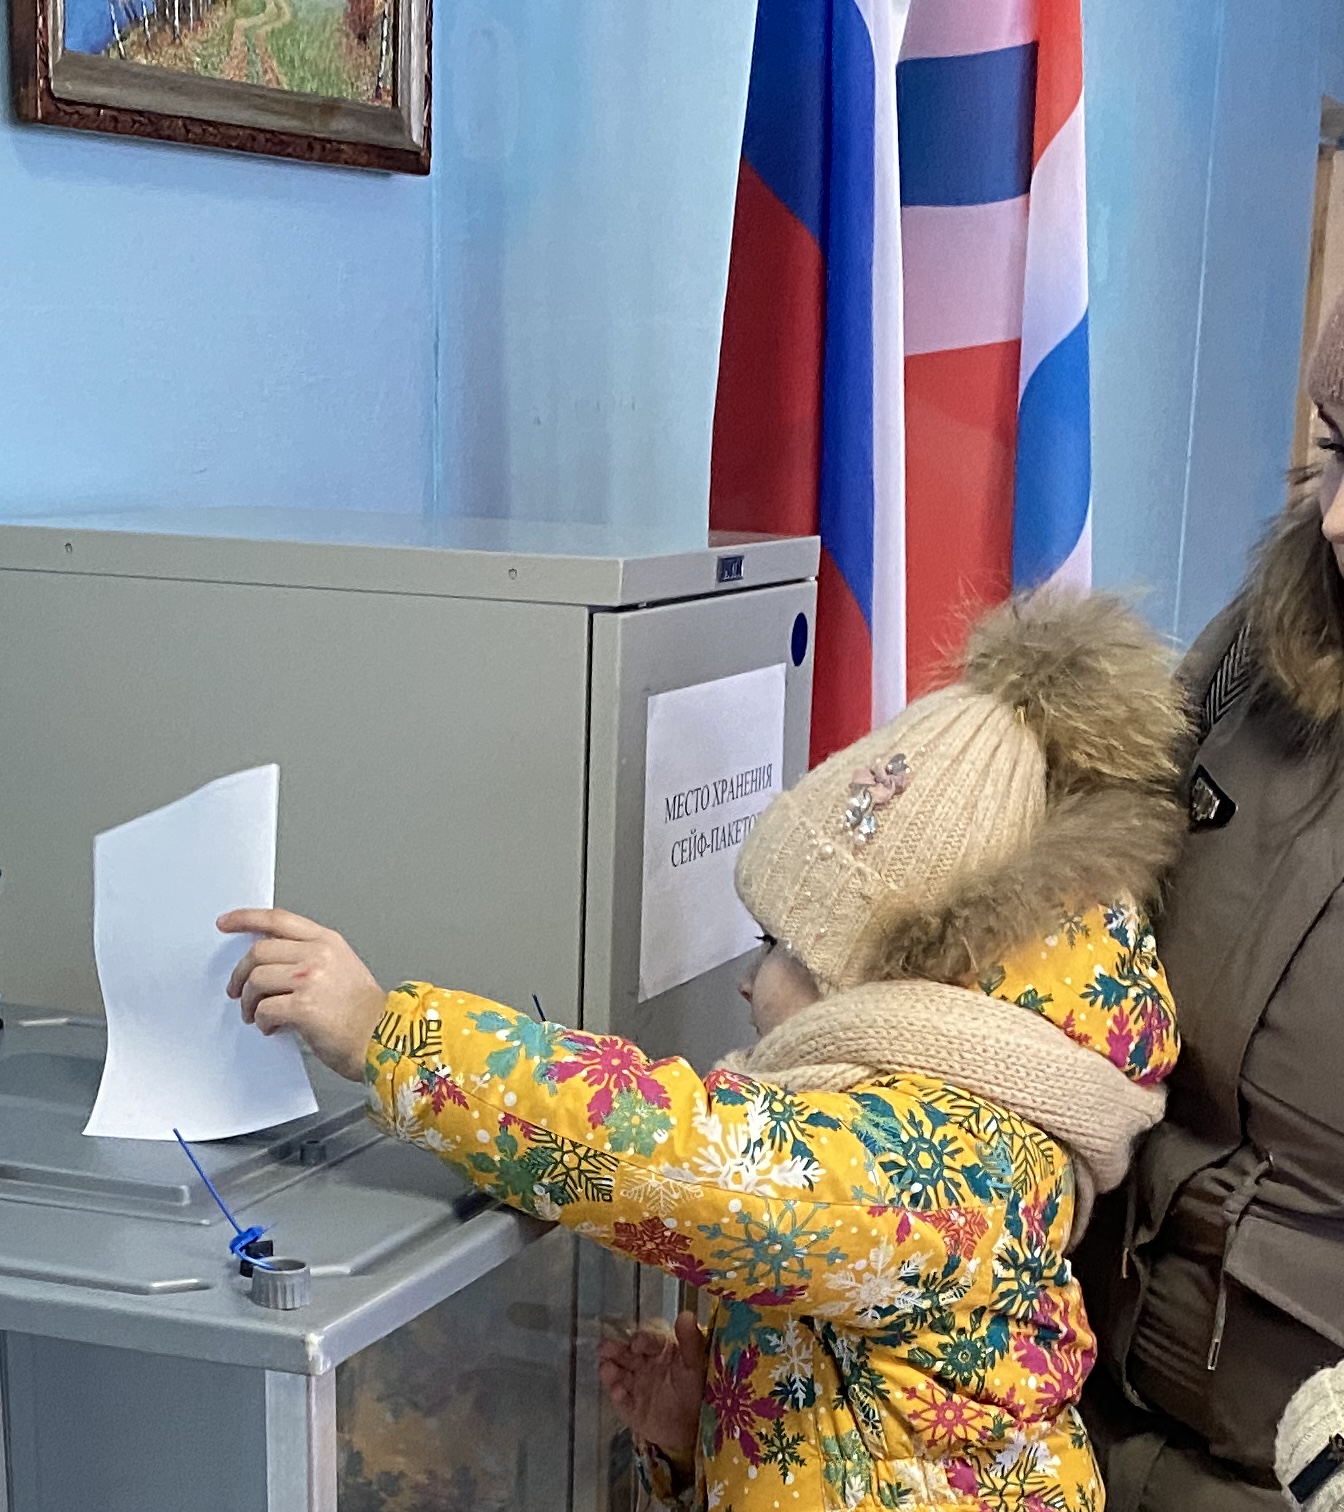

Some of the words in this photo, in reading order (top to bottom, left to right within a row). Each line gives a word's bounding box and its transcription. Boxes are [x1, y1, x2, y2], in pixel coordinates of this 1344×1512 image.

[664, 784, 710, 824] МЕСТО
[711, 763, 773, 808] ХРАНЕНИЯ
[671, 811, 762, 868] СЕЙФ-ПАКЕТО
